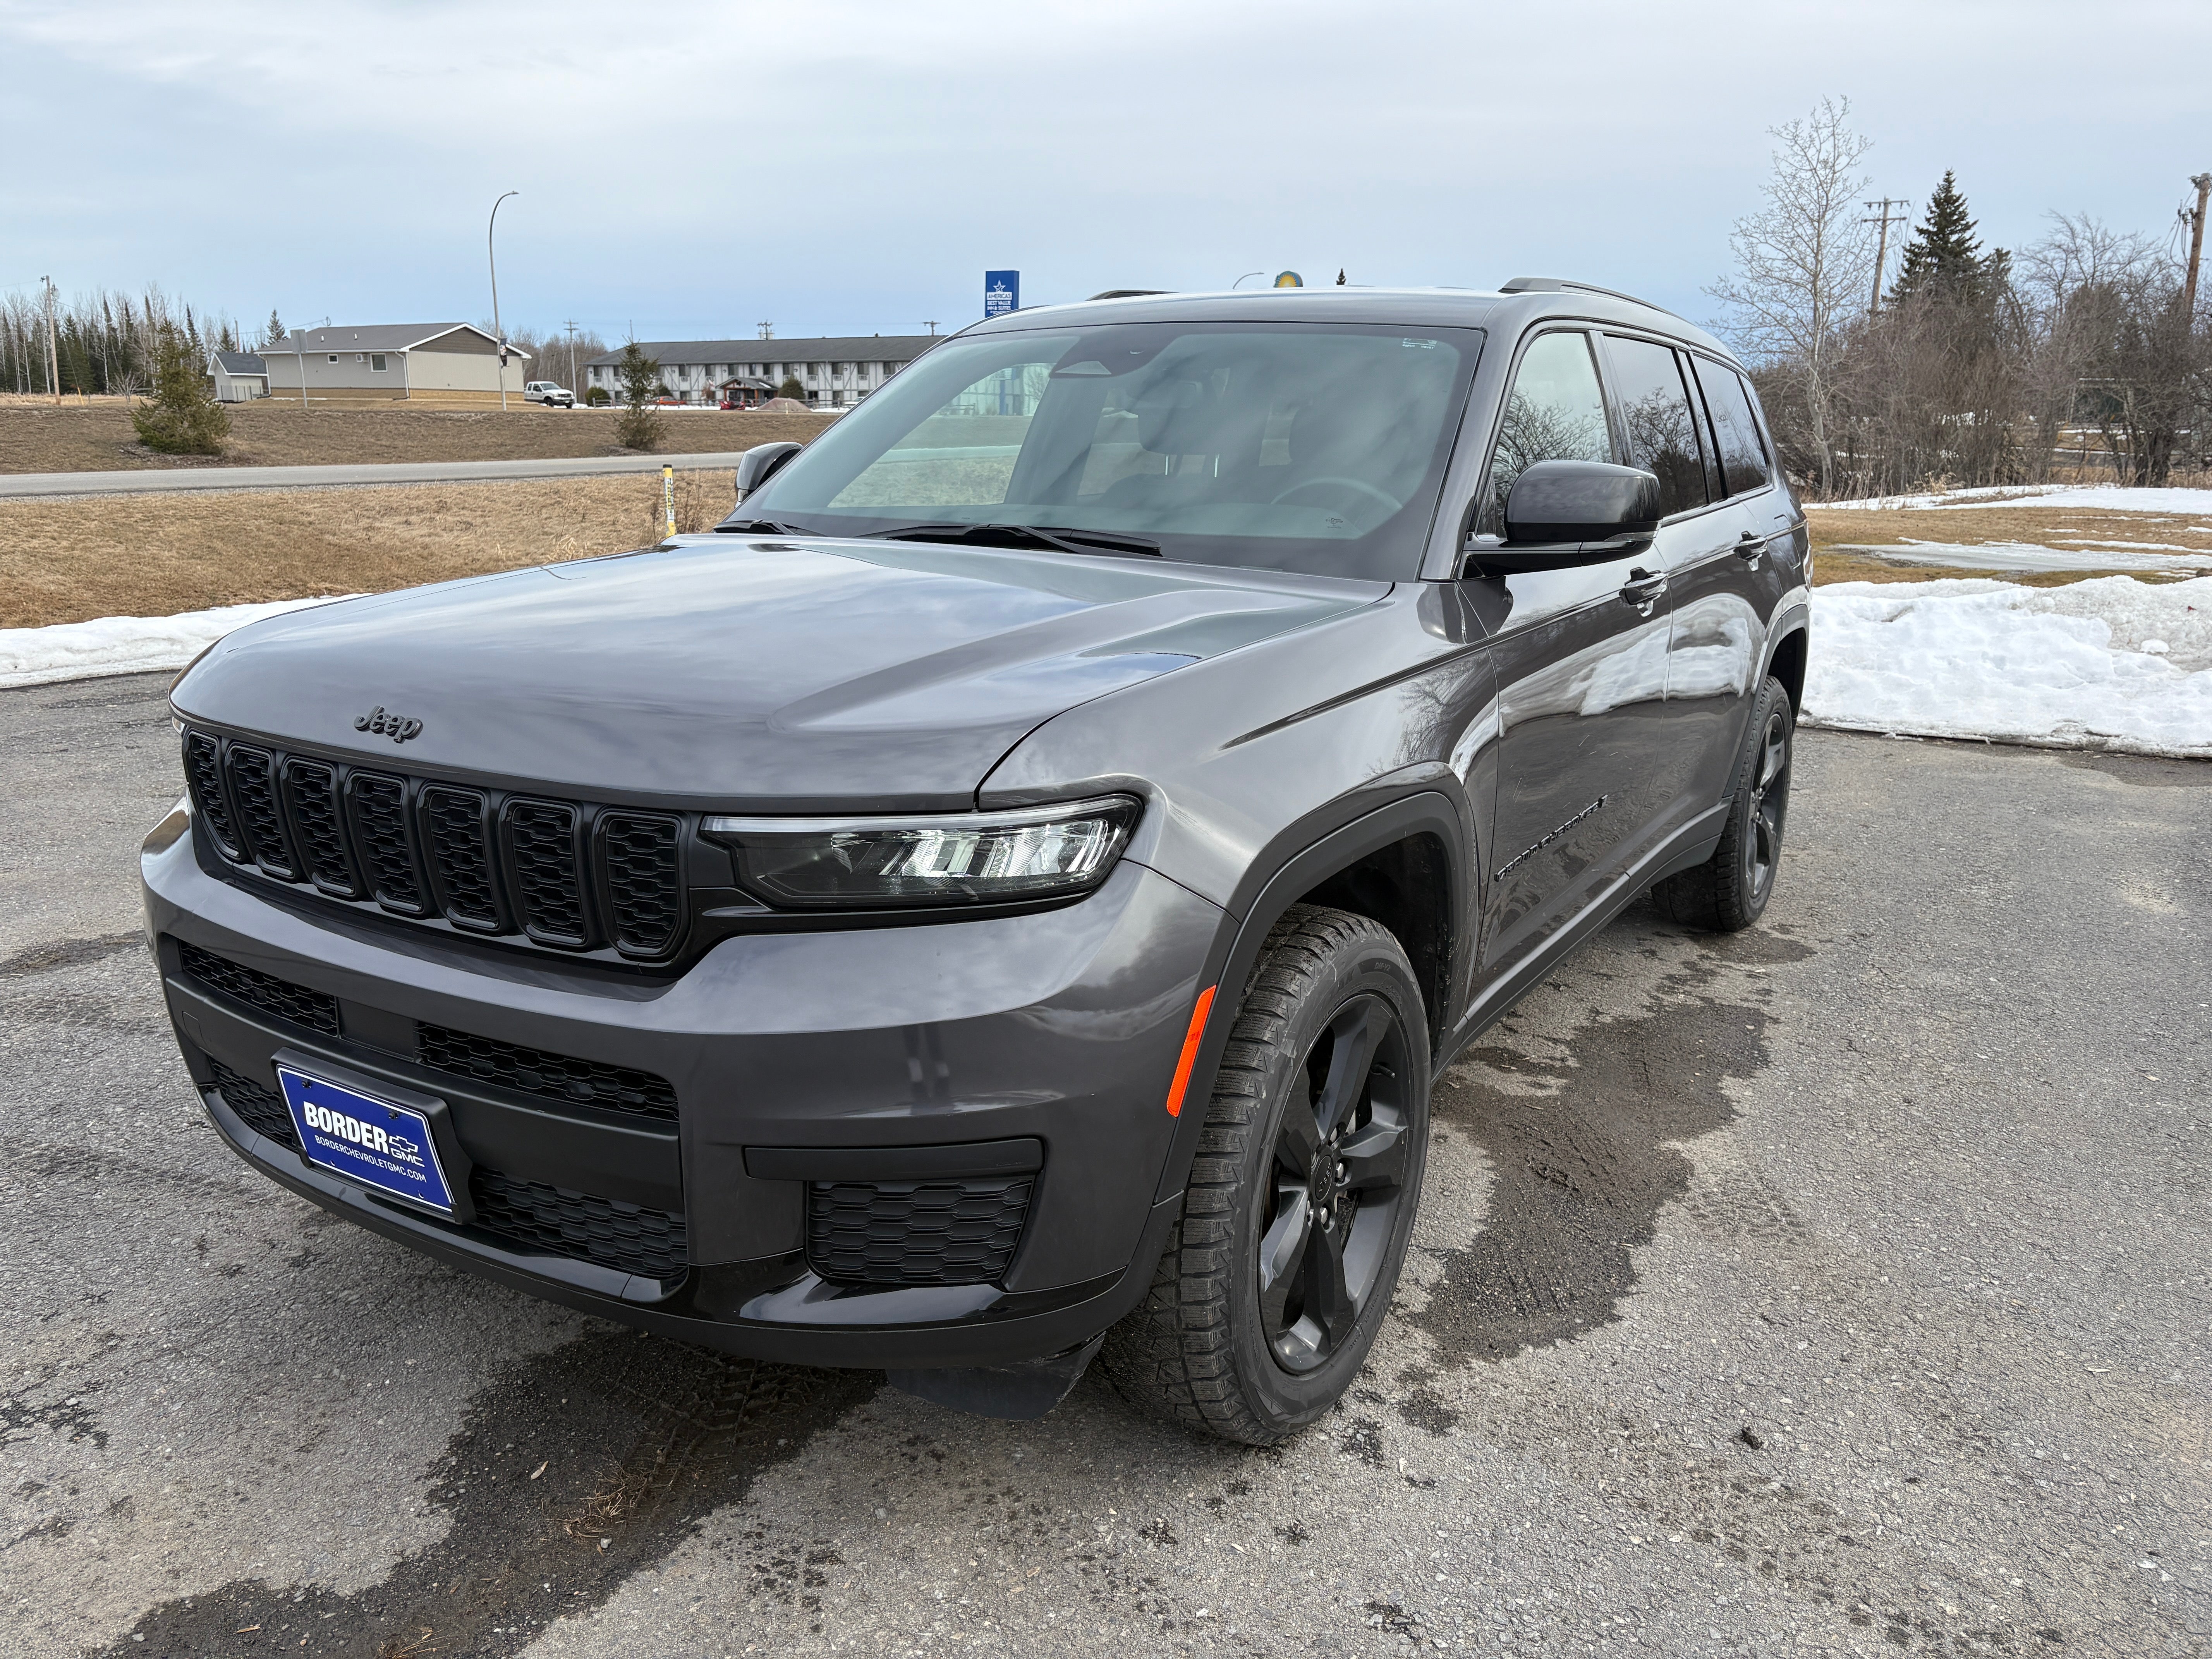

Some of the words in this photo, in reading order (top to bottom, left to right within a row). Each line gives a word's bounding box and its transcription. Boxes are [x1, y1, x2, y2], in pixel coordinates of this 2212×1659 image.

[354, 705, 423, 744] Jeep
[303, 1101, 389, 1154] BORDER
[315, 1135, 427, 1183] BORDERCHEVROLETGMC.COM
[390, 1148, 425, 1168] GMC
